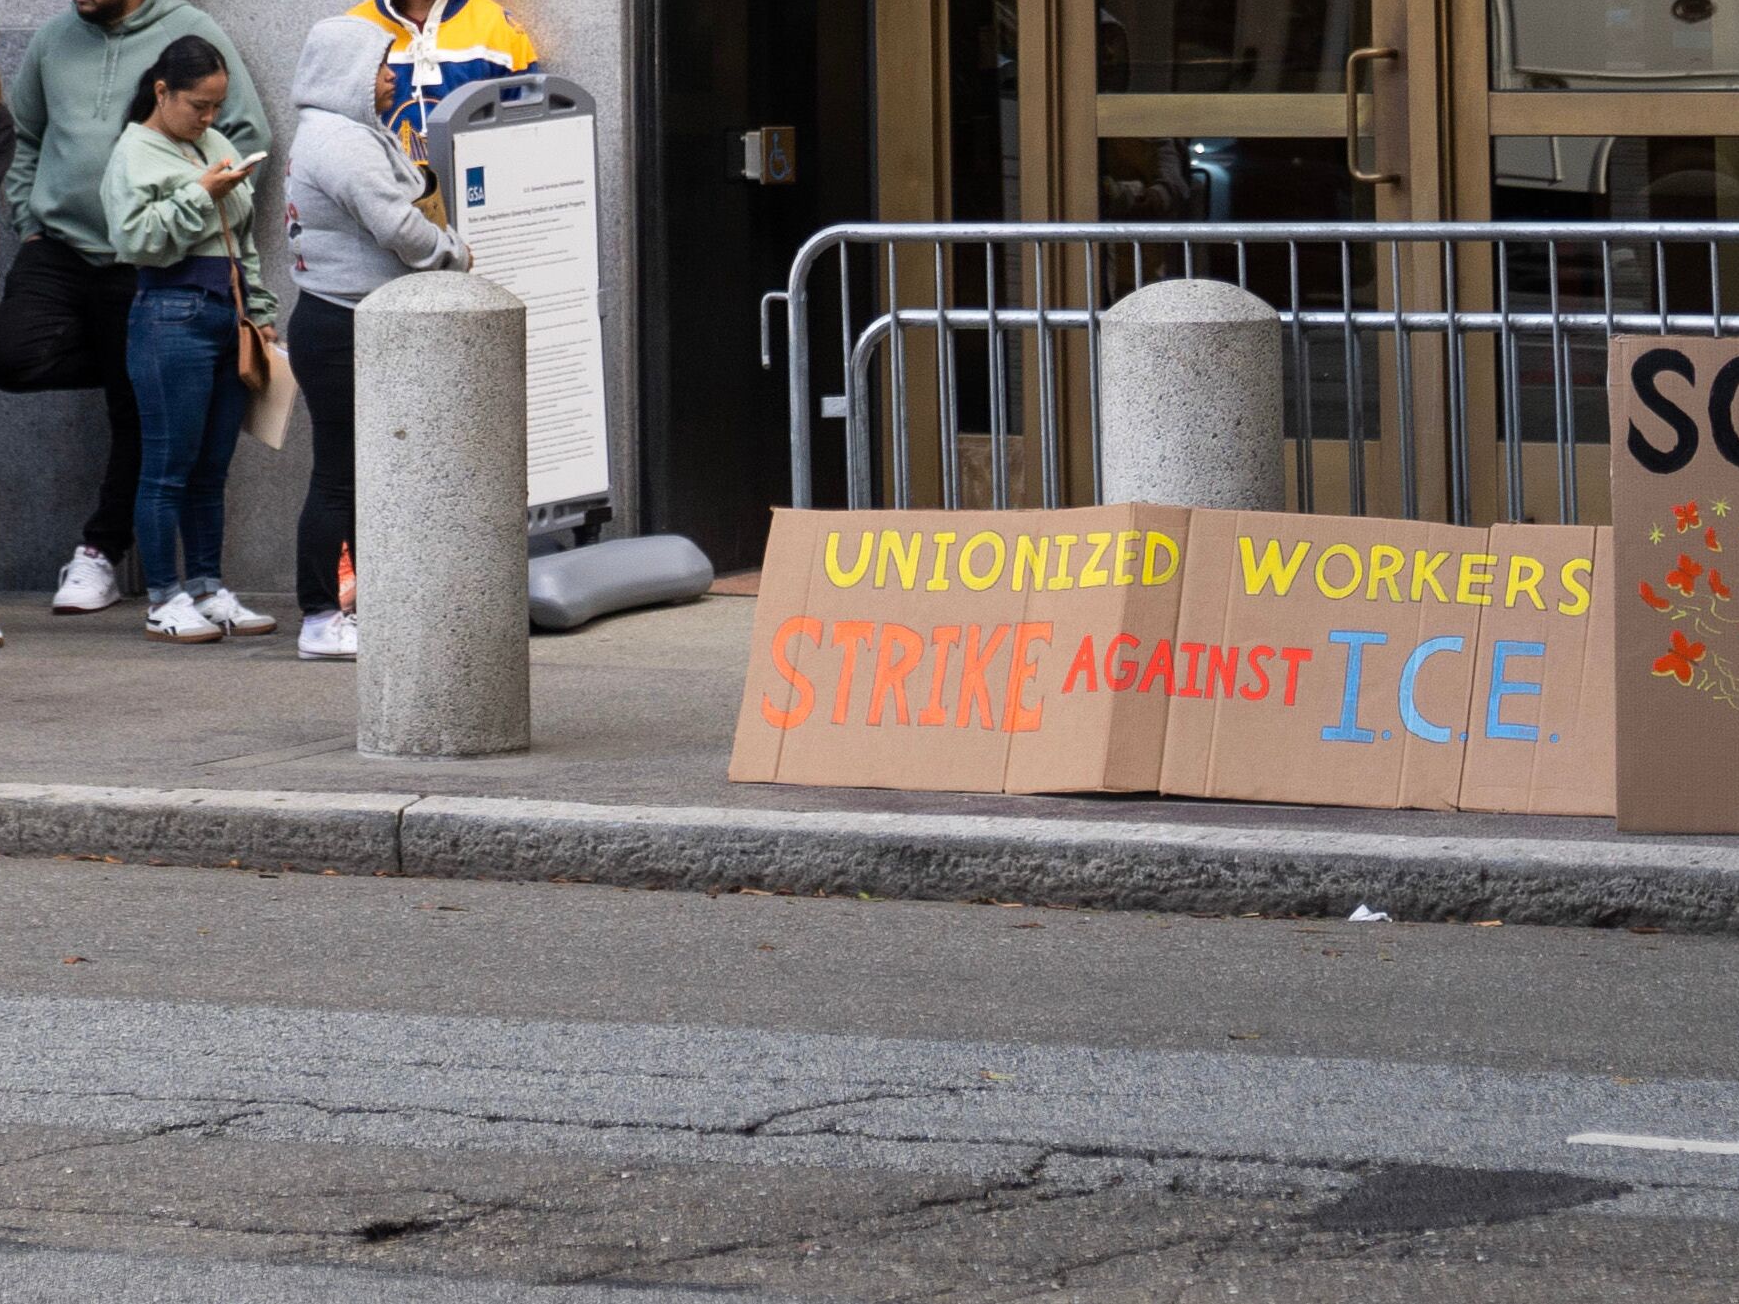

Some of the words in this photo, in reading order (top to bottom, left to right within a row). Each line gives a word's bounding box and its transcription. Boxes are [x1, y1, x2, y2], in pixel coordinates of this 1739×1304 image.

[468, 185, 485, 202] GSA
[823, 528, 1181, 595] UNIONIZED
[1236, 536, 1594, 617] WORKERS
[760, 615, 1055, 734] STRIKE
[1060, 632, 1314, 707] AGAINST
[1319, 629, 1562, 745] I.C.E.
